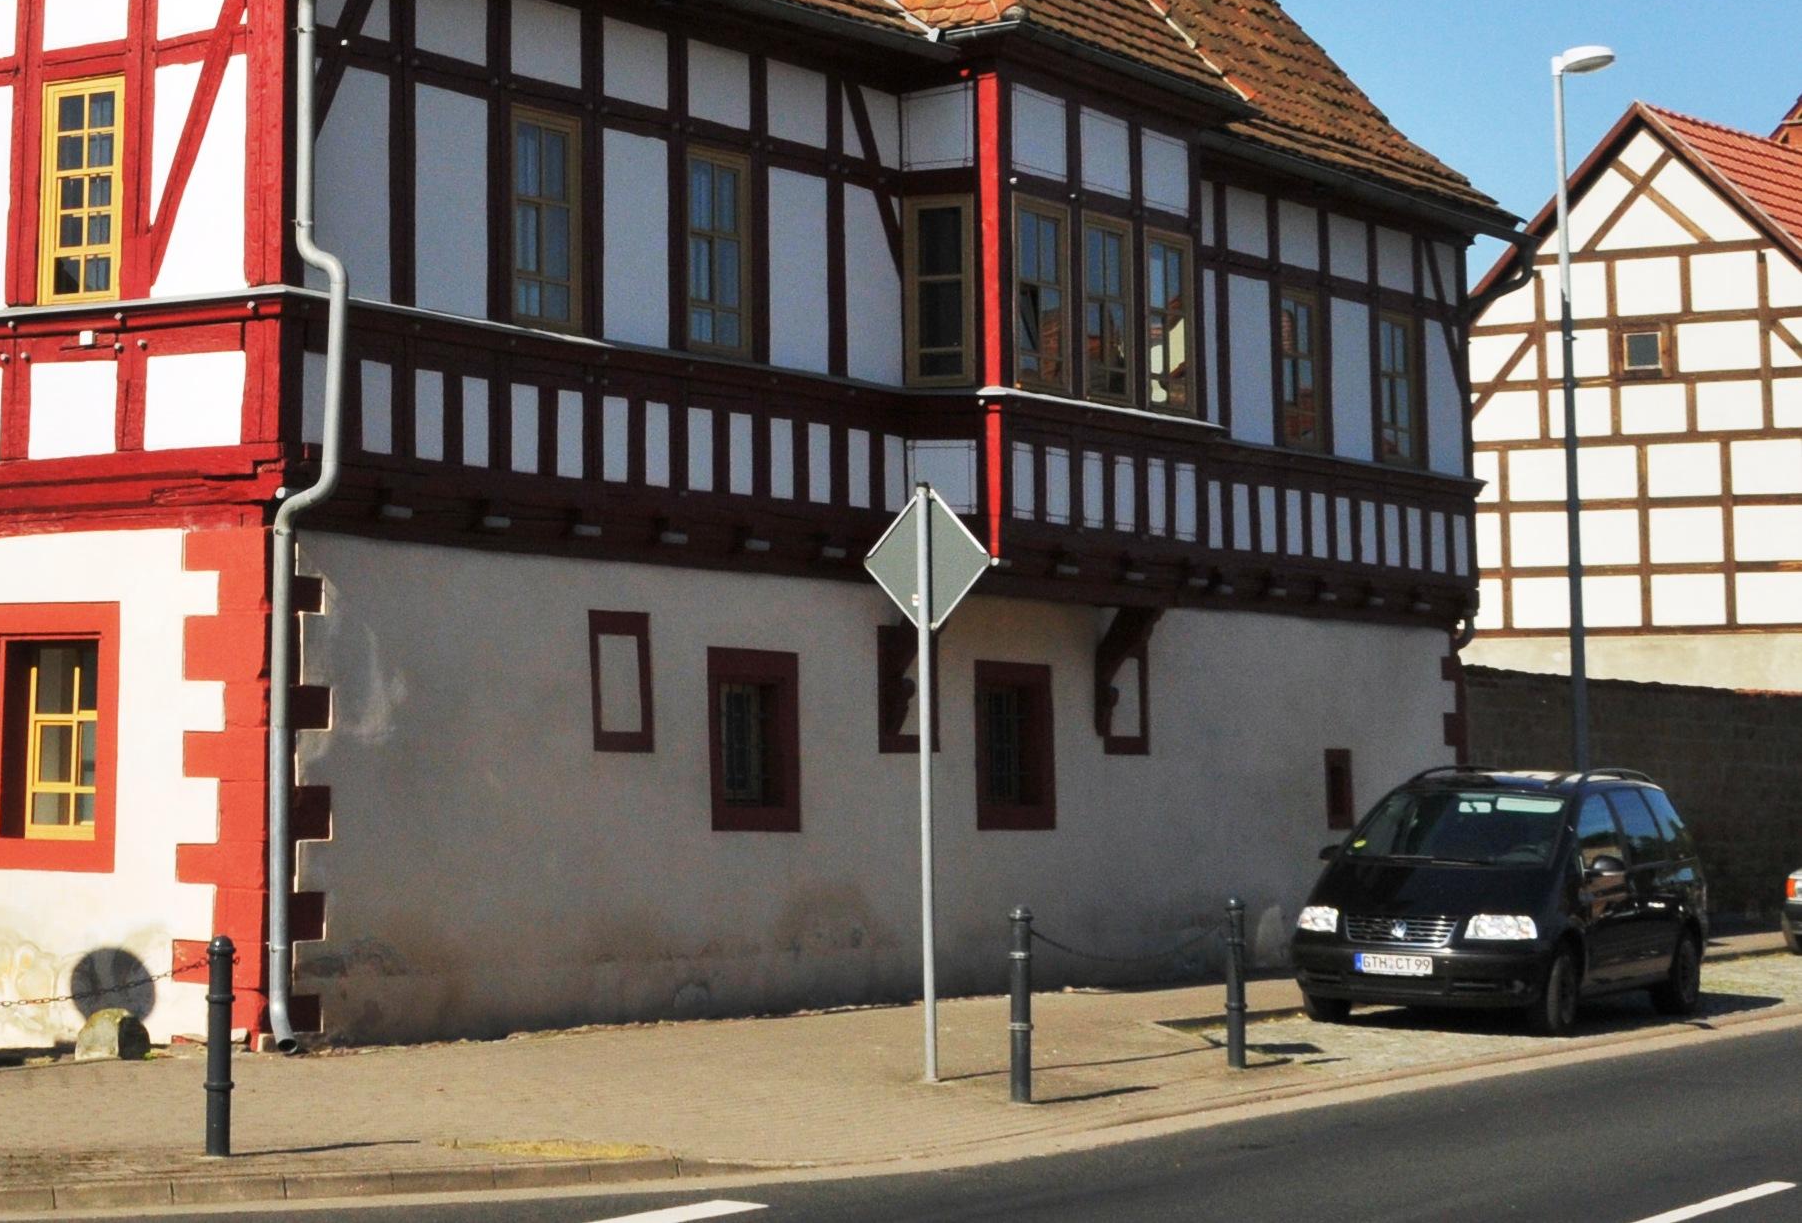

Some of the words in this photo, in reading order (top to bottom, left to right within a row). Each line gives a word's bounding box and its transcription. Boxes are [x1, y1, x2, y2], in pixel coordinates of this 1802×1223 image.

[1363, 955, 1388, 969] GTH
[1395, 956, 1412, 970] CT
[1414, 958, 1431, 971] 99
